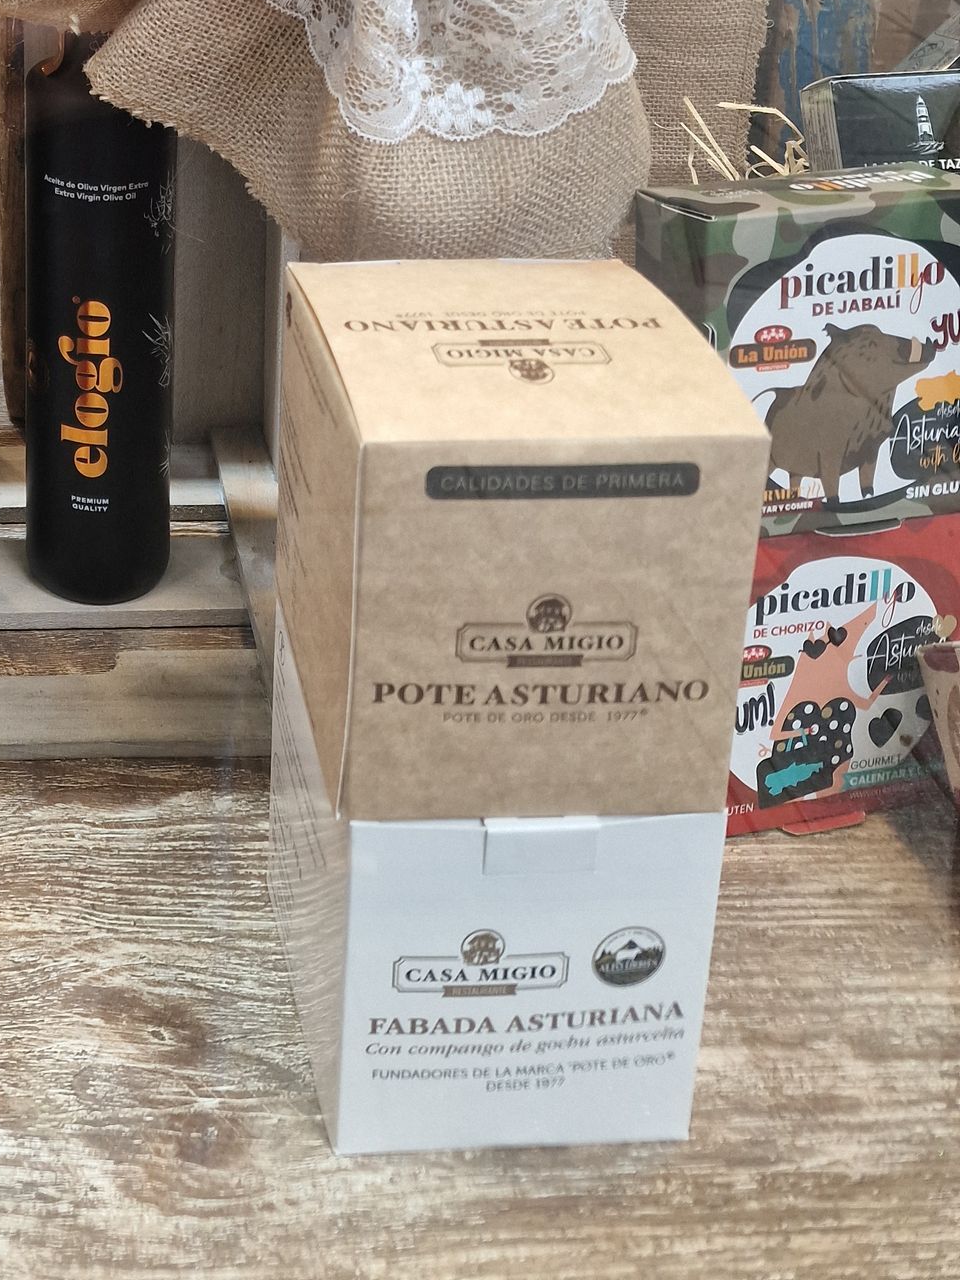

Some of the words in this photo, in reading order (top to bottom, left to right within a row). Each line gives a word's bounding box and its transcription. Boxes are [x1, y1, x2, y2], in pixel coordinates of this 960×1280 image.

[44, 174, 65, 187] Aceite
[66, 181, 75, 189] de
[77, 183, 98, 192] Oliva
[100, 184, 127, 193] Virgen
[129, 181, 149, 190] Extra
[55, 187, 75, 199] Extra
[76, 192, 100, 202] Virgin
[103, 194, 123, 202] Olive
[125, 192, 136, 200] Oil
[812, 302, 833, 317] DE
[837, 290, 901, 314] JABALÍ
[344, 319, 555, 332] ASTURIANO
[568, 318, 662, 330] POTE
[447, 348, 524, 358] MIGIO
[535, 348, 596, 358] CASA
[738, 348, 758, 363] La
[763, 346, 808, 361] Unión
[58, 300, 123, 478] elogio
[441, 475, 554, 492] CALIDADES
[563, 475, 587, 490] DE
[596, 471, 684, 489] PRIMERA
[71, 495, 109, 505] PREMIUM
[906, 486, 929, 499] SIN
[72, 503, 108, 512] QUALITY
[753, 628, 768, 639] DE
[771, 620, 825, 636] CHORIZO
[469, 635, 532, 651] CASA
[544, 635, 624, 651] MIGIO
[742, 661, 786, 678] Unión
[372, 682, 476, 705] POTE
[484, 680, 709, 705] ASTURIANO
[405, 968, 469, 983] CASA
[478, 965, 556, 981] MIGIO
[368, 1017, 495, 1035] FABADA
[506, 1002, 684, 1032] ASTURIANA
[366, 1041, 402, 1056] Con
[408, 1041, 504, 1058] compango
[510, 1039, 532, 1053] de
[535, 1036, 591, 1054] gochu
